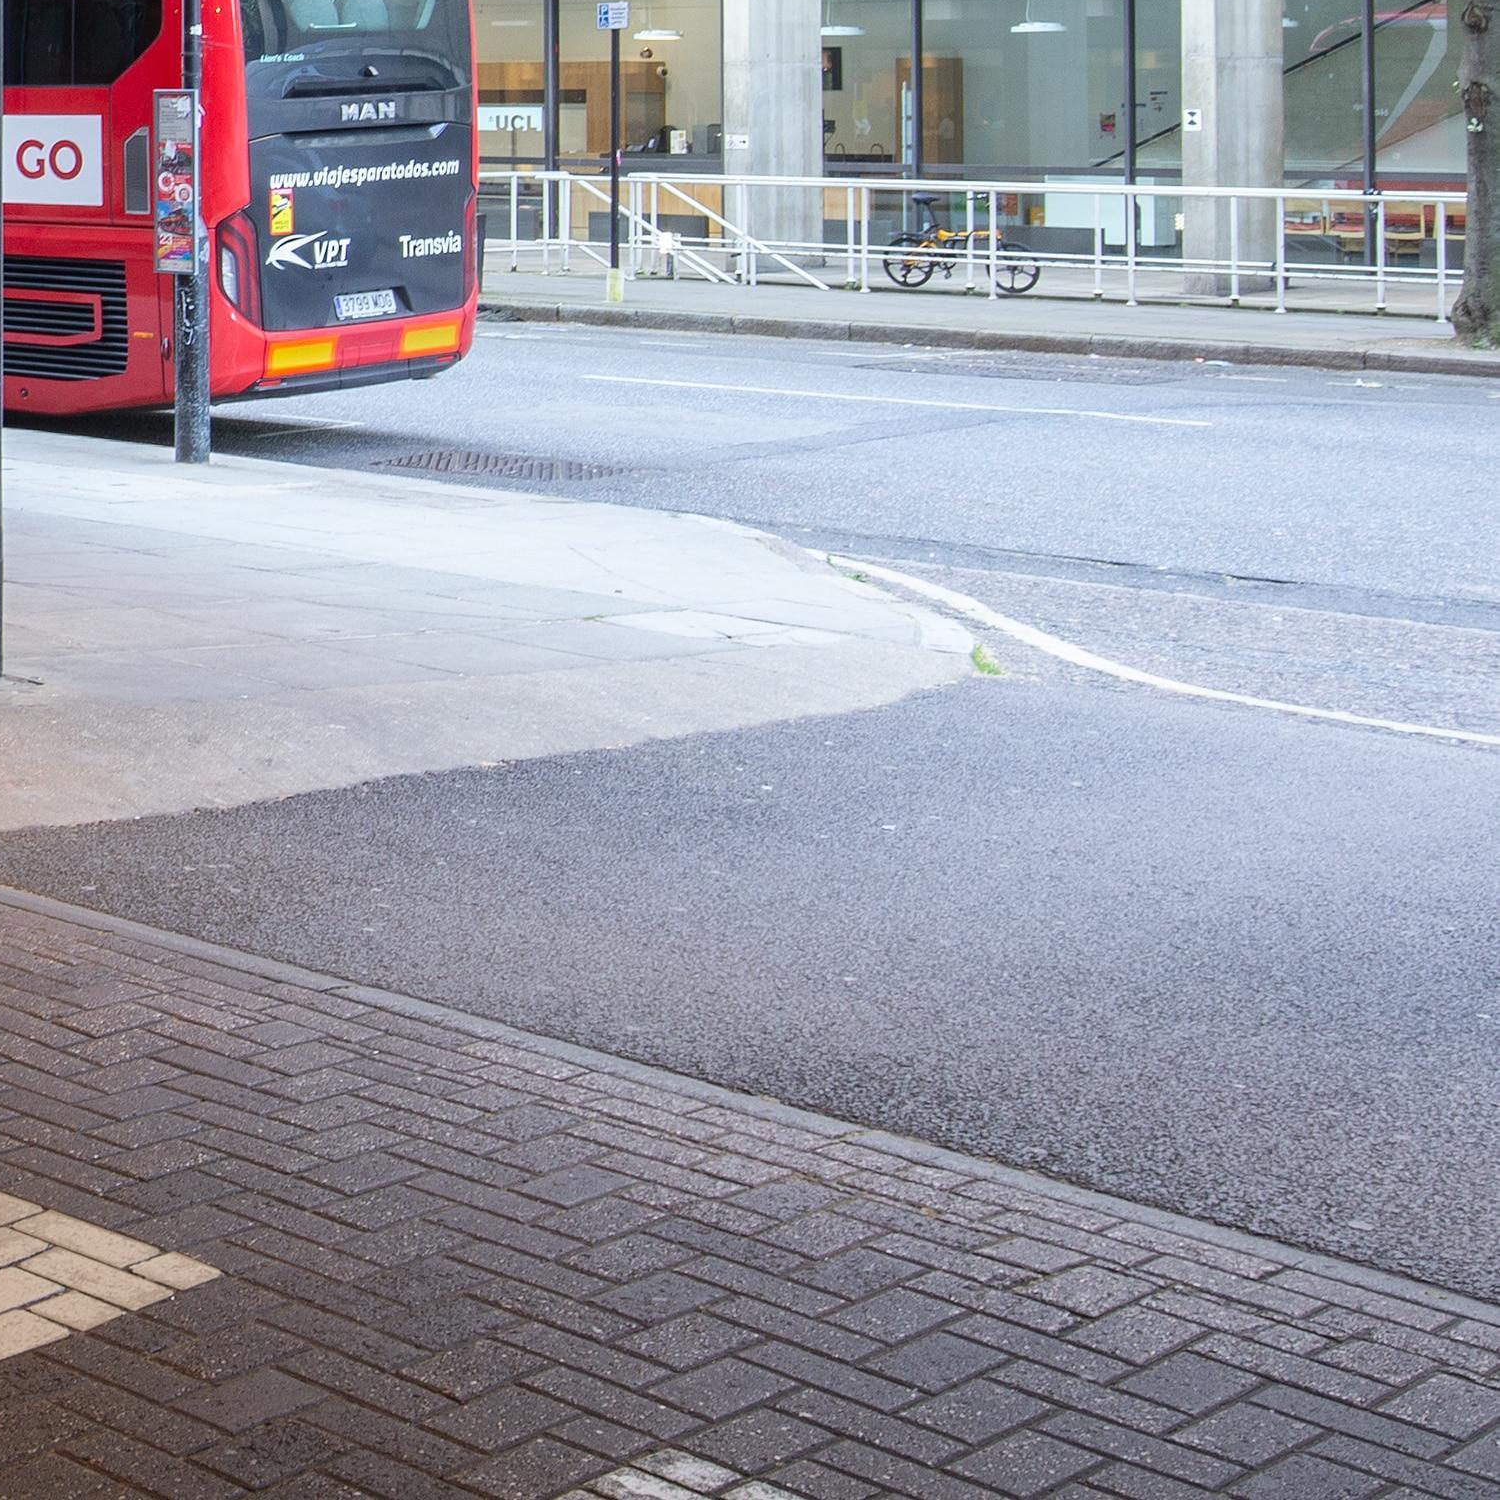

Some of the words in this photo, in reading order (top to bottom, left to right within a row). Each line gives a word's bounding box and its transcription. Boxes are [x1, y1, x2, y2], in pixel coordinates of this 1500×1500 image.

[341, 101, 396, 121] MAN
[495, 115, 537, 131] UCL
[16, 139, 84, 181] GO
[269, 159, 460, 189] www.viajesparatodos.com
[313, 237, 351, 264] VPT
[399, 229, 462, 258] Transvia
